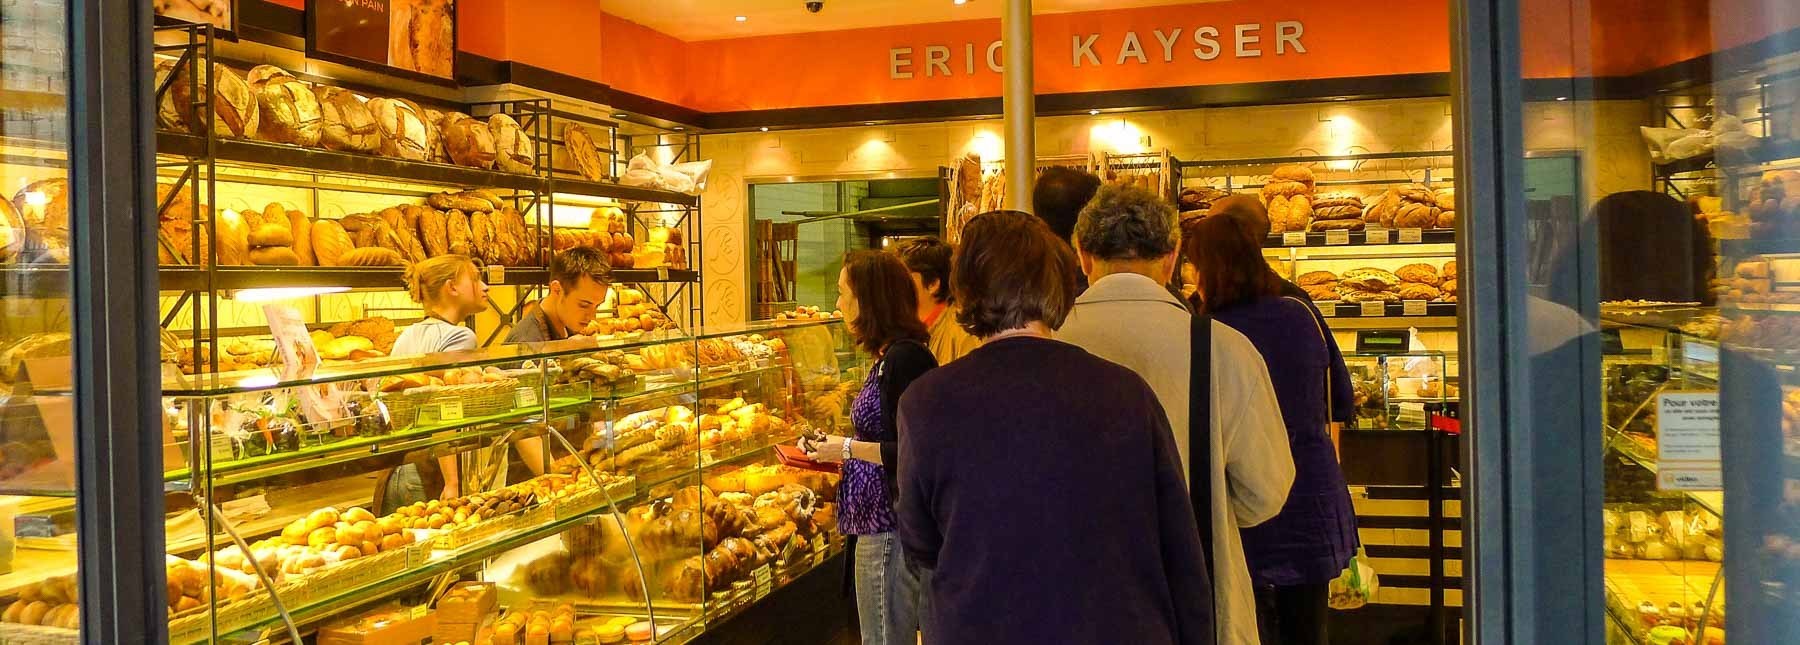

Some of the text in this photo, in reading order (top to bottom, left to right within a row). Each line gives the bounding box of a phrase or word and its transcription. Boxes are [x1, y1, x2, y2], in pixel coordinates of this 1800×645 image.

[361, 0, 384, 13] PAIN
[889, 20, 1307, 79] ERIC KAYSER
